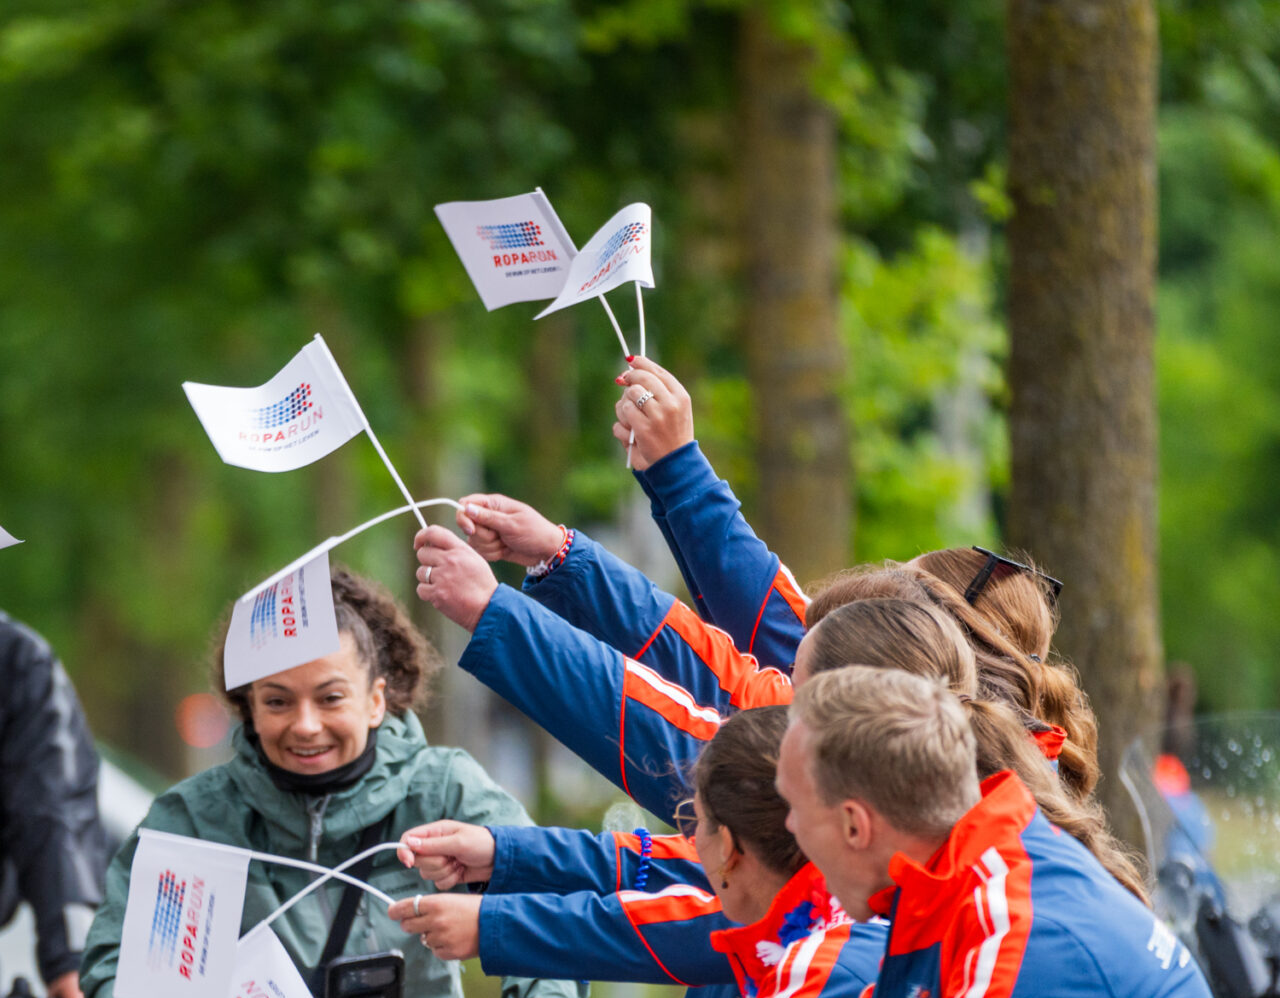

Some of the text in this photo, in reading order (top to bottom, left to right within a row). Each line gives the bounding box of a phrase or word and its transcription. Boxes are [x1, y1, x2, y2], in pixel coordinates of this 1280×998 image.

[494, 249, 558, 268] ROPARUN
[238, 406, 324, 443] ROPARUN
[179, 875, 205, 981] ROPARUN
